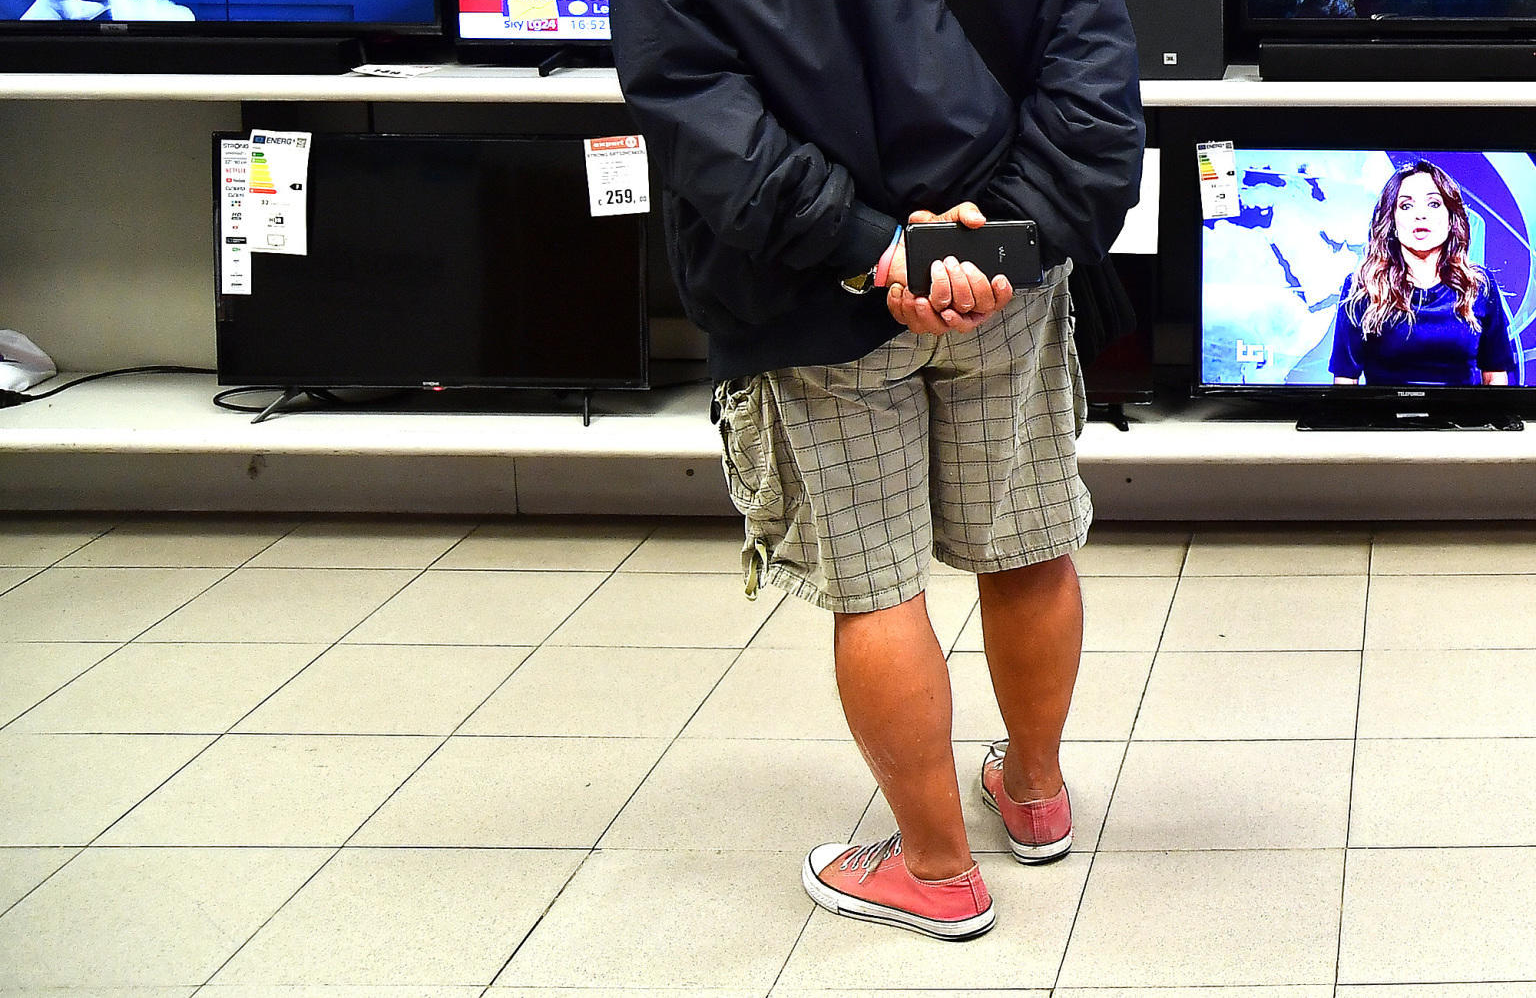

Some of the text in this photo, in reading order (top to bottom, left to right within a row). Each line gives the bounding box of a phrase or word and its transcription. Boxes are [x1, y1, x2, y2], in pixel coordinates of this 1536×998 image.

[571, 20, 606, 30] 16:52
[266, 136, 292, 145] ENERG
[593, 139, 625, 148] expert
